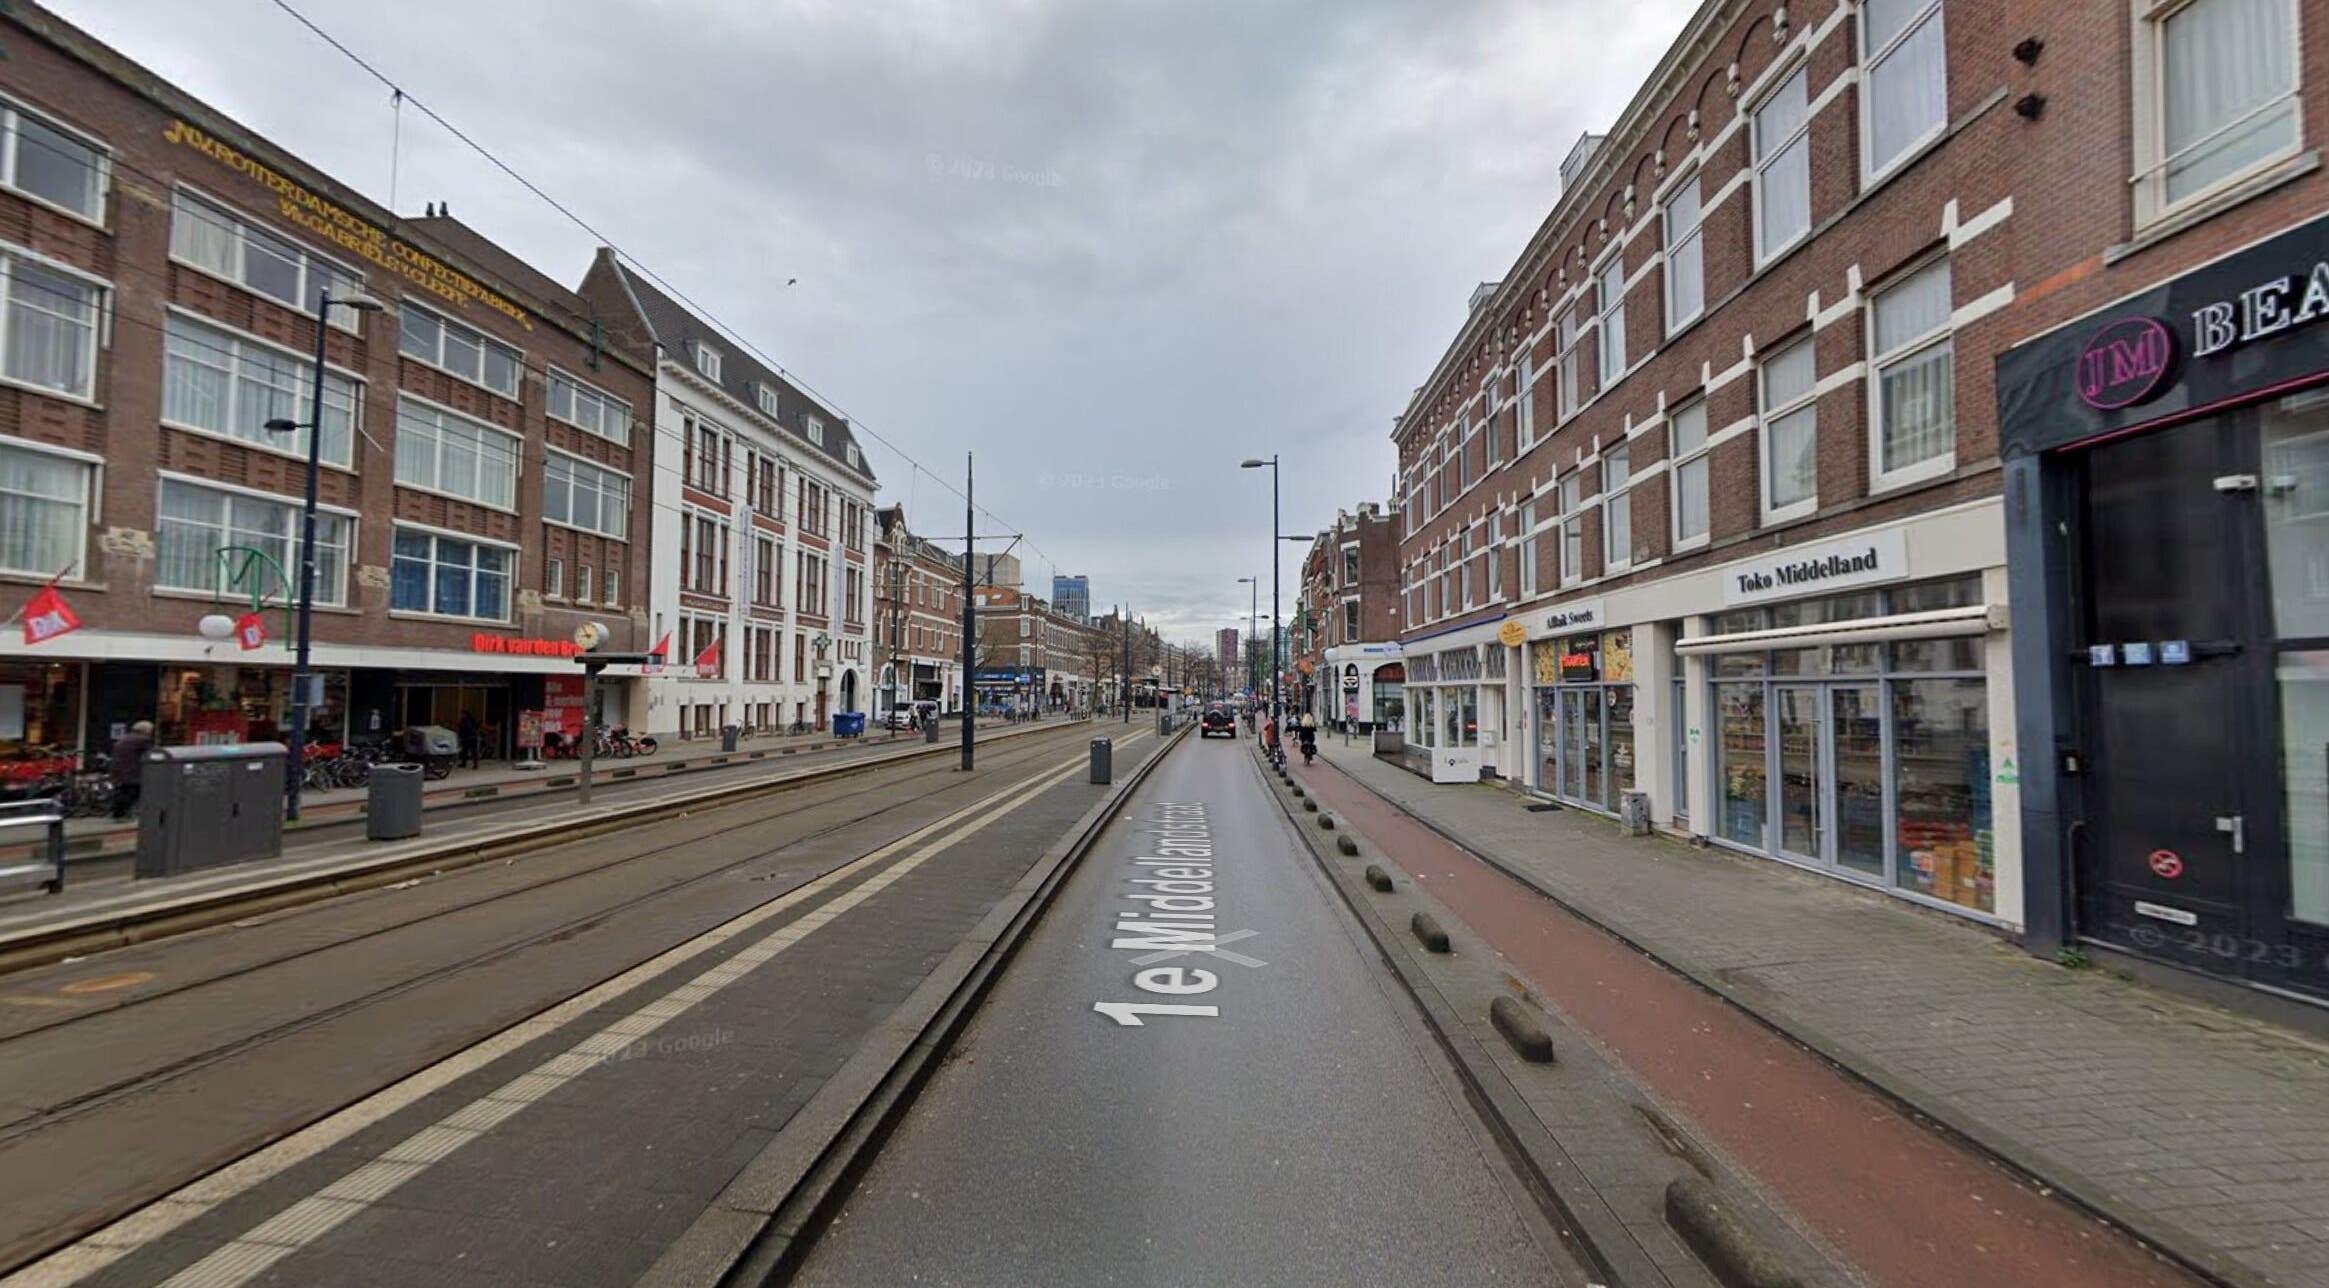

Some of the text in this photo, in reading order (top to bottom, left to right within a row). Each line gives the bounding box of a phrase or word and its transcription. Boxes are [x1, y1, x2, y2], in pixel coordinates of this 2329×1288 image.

[2084, 325, 2162, 396] JM
[1737, 547, 1878, 593] Toko Middelland
[1568, 609, 1594, 626] Sweets
[472, 632, 505, 654] Dirk
[507, 638, 533, 656] van
[534, 638, 559, 657] den
